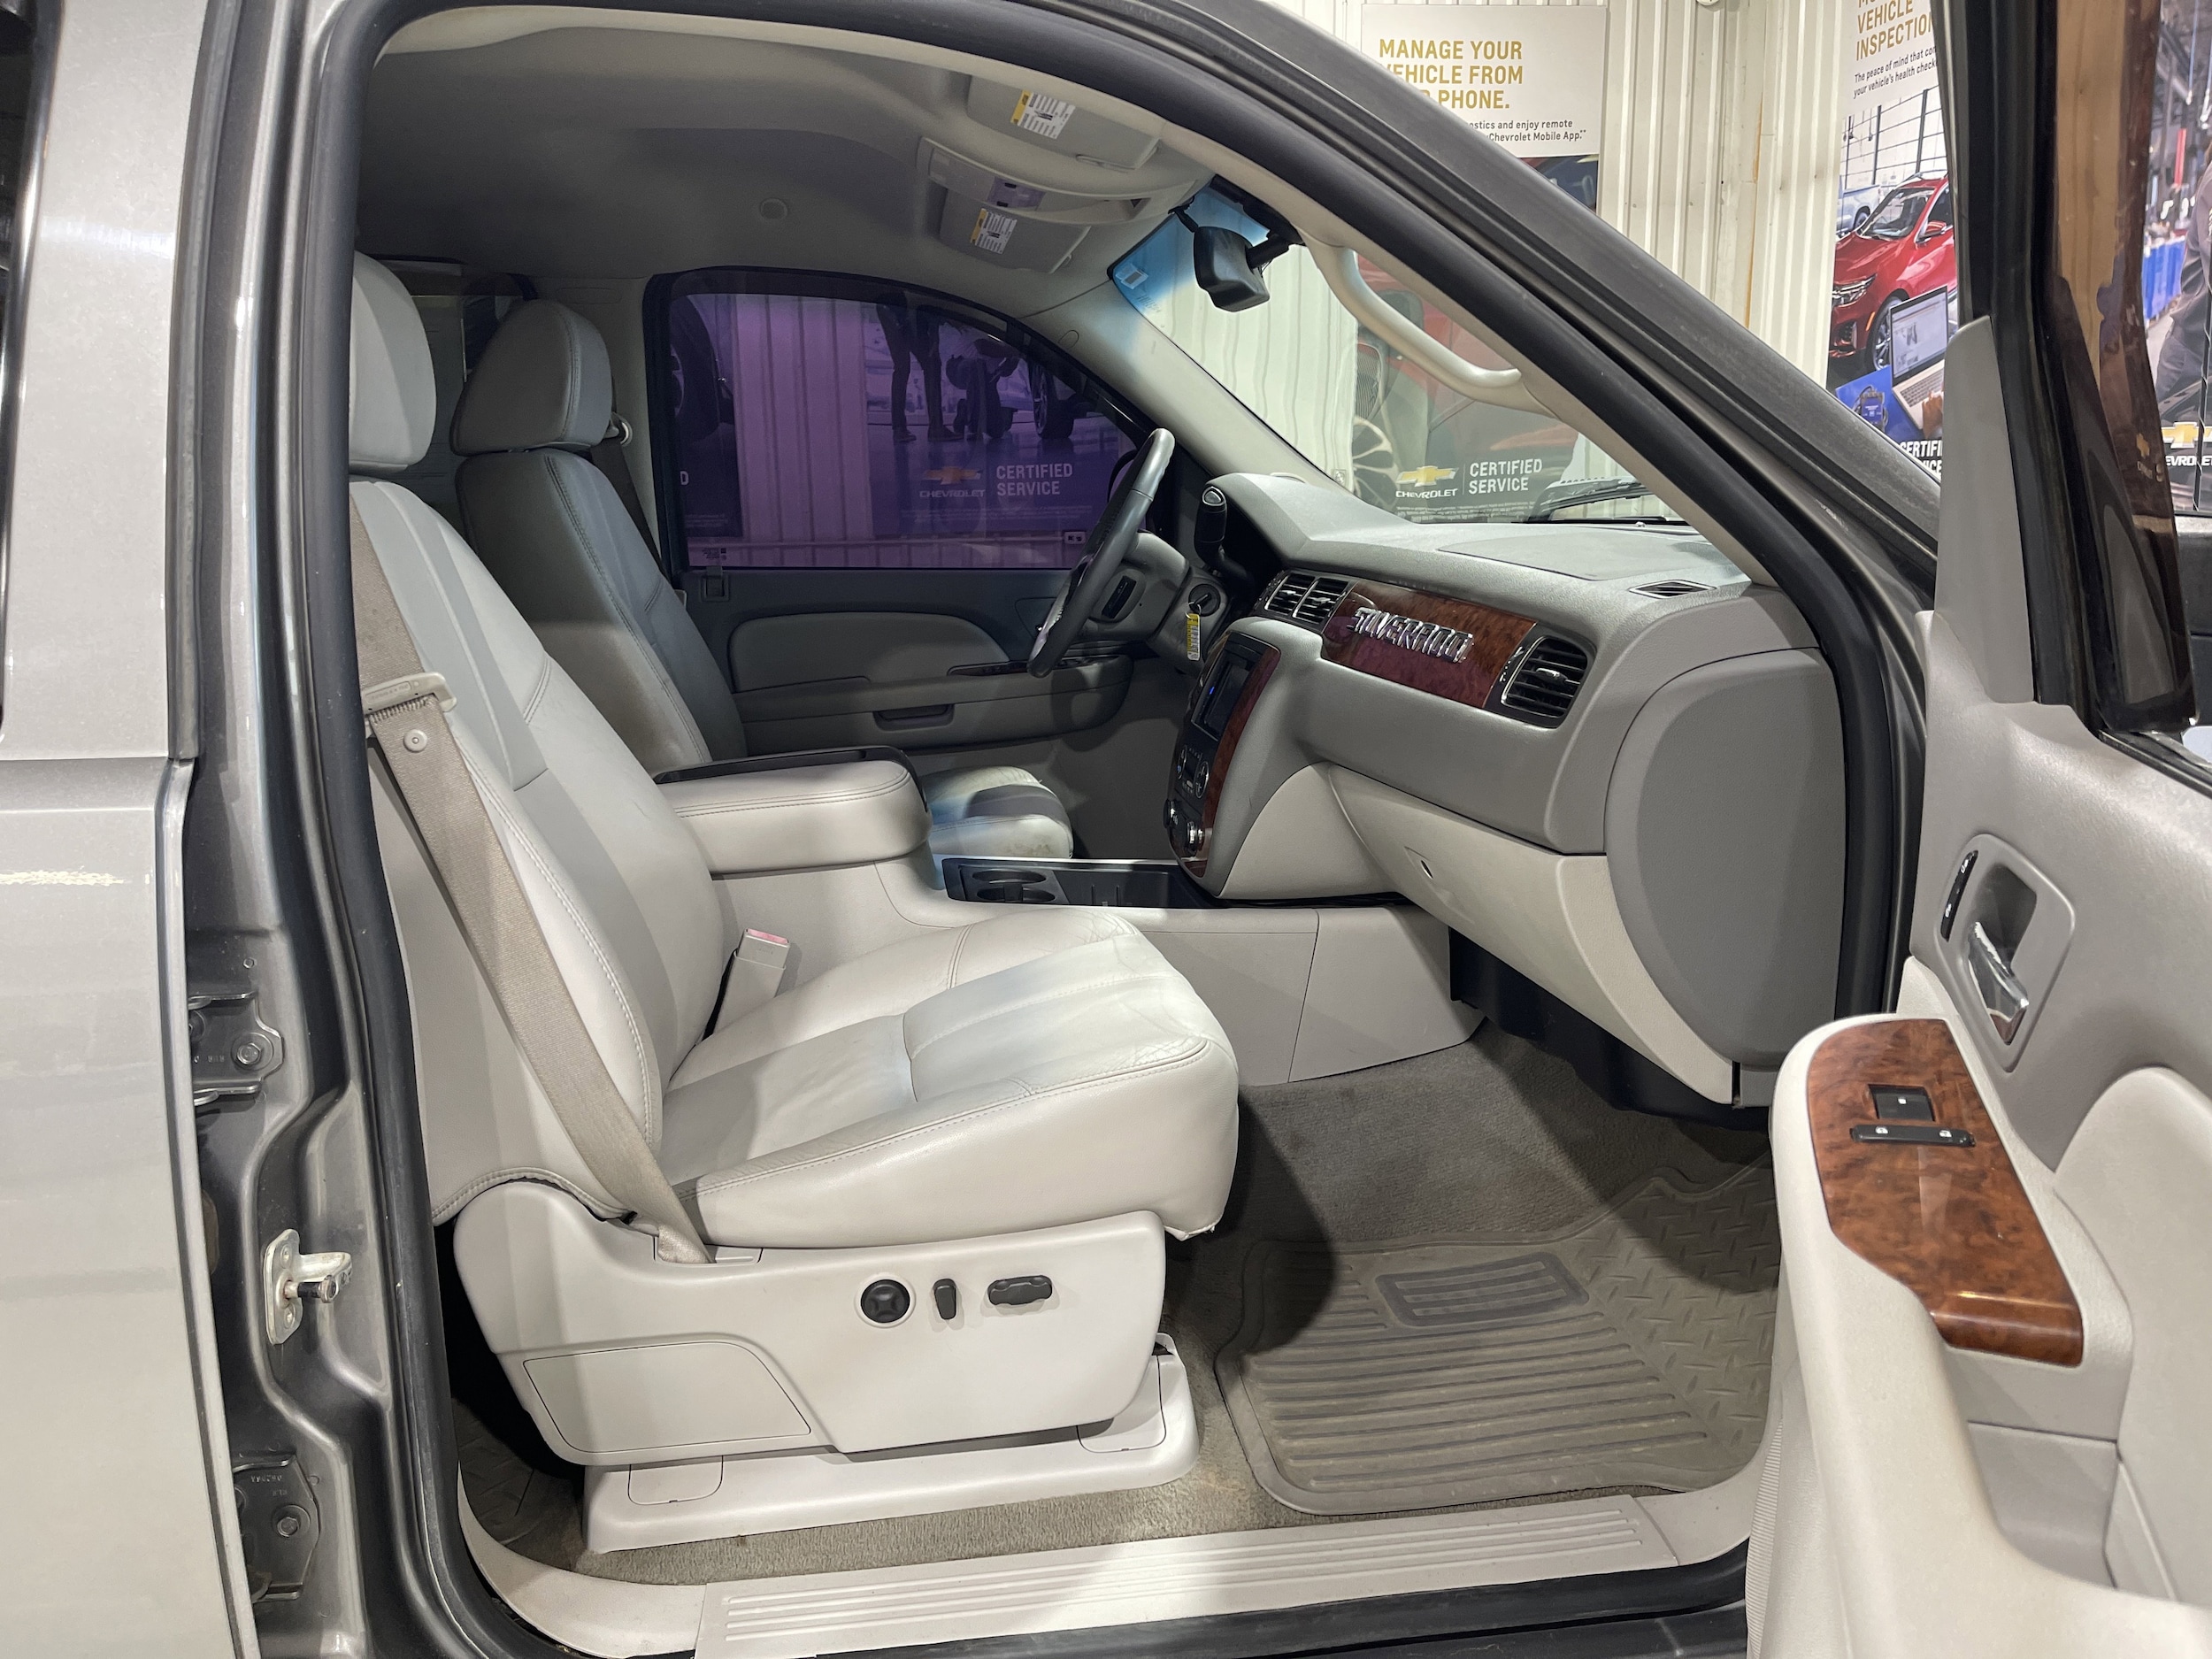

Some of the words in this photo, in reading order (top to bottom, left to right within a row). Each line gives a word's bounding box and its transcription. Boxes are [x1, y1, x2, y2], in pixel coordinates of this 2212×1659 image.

[1857, 0, 1913, 34] VEHICLE
[1379, 39, 1463, 59] MANAGE
[1470, 41, 1523, 60] YOUR
[1387, 64, 1462, 84] EHICLE
[1469, 65, 1523, 84] FROM
[1855, 72, 1865, 83] The
[1866, 65, 1884, 81] peace
[1885, 60, 1893, 72] of
[1893, 53, 1909, 69] mind
[1910, 50, 1924, 63] that
[1853, 85, 1867, 99] your
[1868, 74, 1893, 91] vehicle's
[1894, 66, 1915, 82] health
[1916, 58, 1937, 74] check
[1439, 89, 1509, 109] PHONE.
[1497, 120, 1514, 129] and
[1516, 120, 1540, 131] enjoy
[1541, 119, 1573, 128] remote
[1487, 132, 1531, 142] Chevrolet
[1533, 131, 1561, 141] Mobile
[1900, 441, 1943, 457] CERTIFI
[996, 463, 1073, 480] CERTIFIED
[1469, 458, 1542, 478] CERTIFIED
[919, 489, 986, 498] CHEVROLET
[996, 480, 1061, 496] SERVICE
[1395, 488, 1459, 499] CHEVROLET
[1468, 477, 1529, 495] SERVICE
